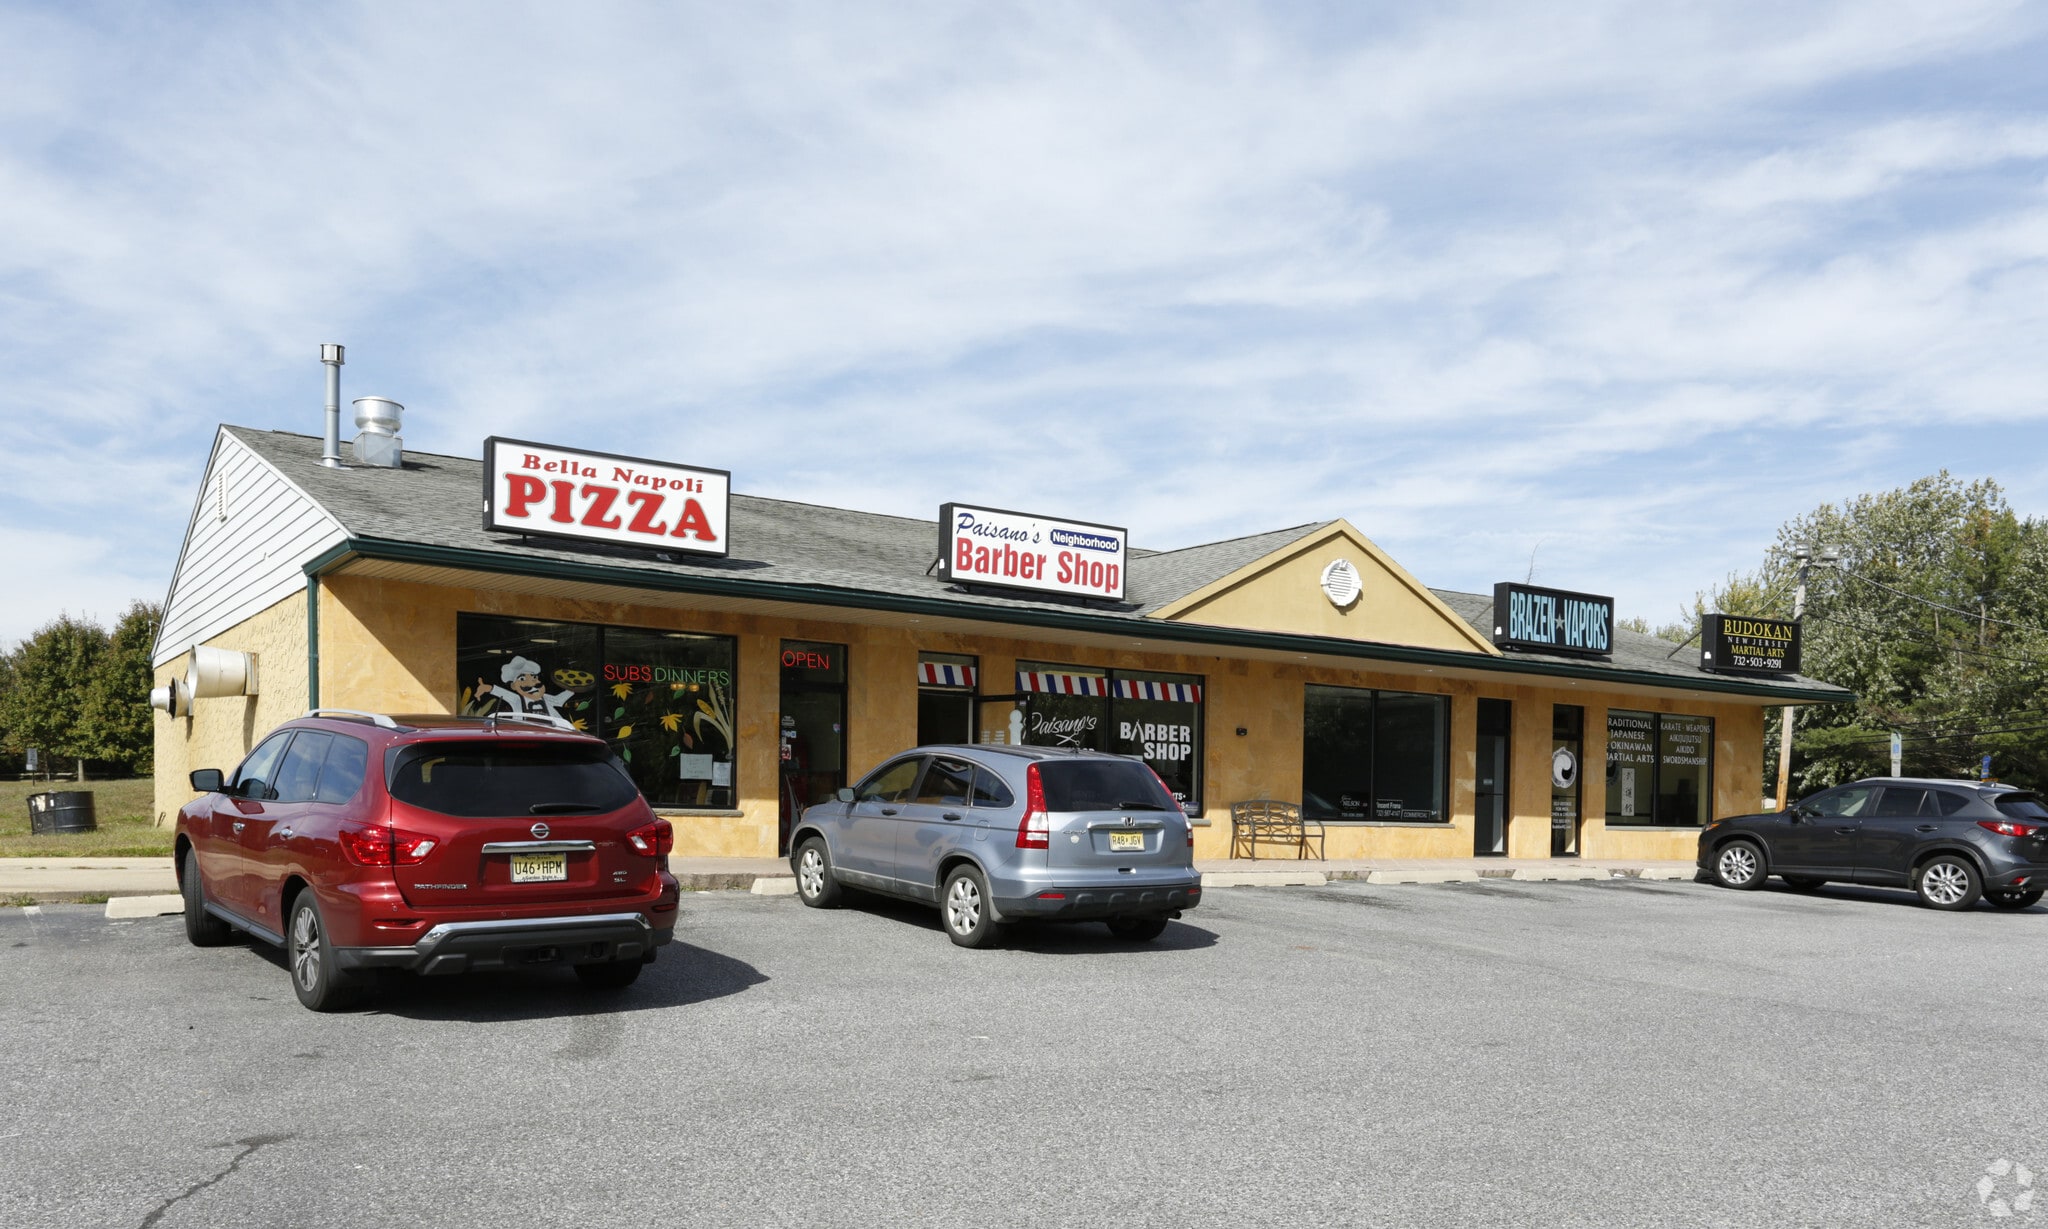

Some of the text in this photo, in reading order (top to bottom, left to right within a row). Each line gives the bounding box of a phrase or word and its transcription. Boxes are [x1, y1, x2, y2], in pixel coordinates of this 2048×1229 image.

[522, 454, 704, 493] Bella Napoli
[503, 473, 718, 542] PIZZA
[956, 512, 1118, 551] Paisano's Neighborhood
[956, 537, 1119, 593] Barber Shop
[1510, 591, 1608, 650] BRAZEN VAPORS
[1724, 619, 1793, 639] BUDOKAN
[1728, 636, 1789, 648] NEW JERSEY
[782, 650, 830, 671] OPEN
[1731, 645, 1785, 658] MARTIAL ARTS
[604, 663, 729, 686] SUBS DINNERS
[1120, 719, 1190, 743] BARBER
[1608, 717, 1652, 729] RADITIONAL
[1660, 722, 1681, 731] KARATE
[1686, 723, 1710, 733] WEAPONS
[1610, 729, 1645, 740] JAPANESE
[1144, 742, 1191, 760] SHOP
[1611, 740, 1653, 752] OKINAWAN
[1676, 745, 1695, 754] AIKIDO
[1636, 754, 1655, 763] ARTS
[1663, 755, 1707, 765] SWORDSMANSHIP
